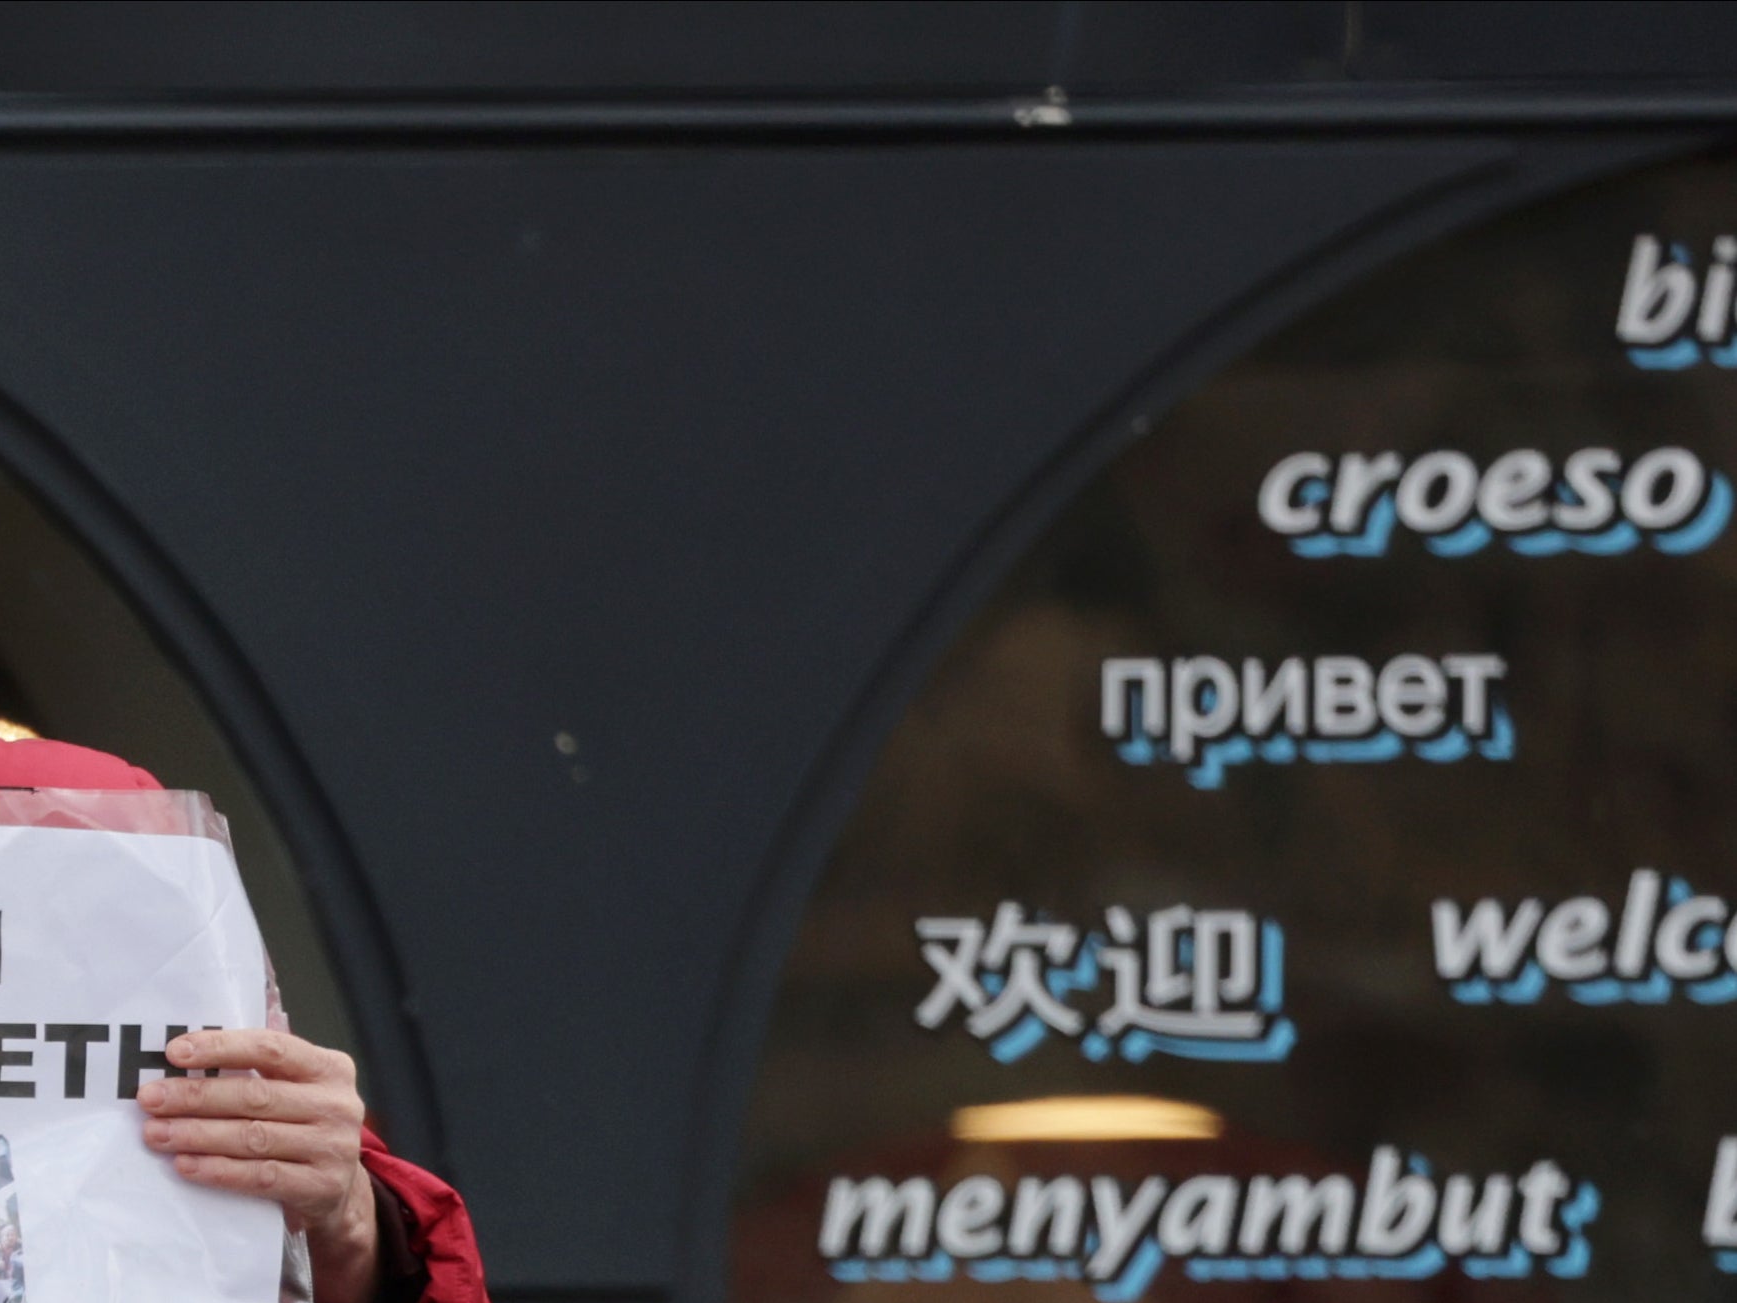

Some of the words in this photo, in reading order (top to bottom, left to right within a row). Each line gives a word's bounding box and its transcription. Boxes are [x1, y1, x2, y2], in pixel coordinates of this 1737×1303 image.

[1258, 447, 1706, 535] croeso
[1101, 654, 1505, 762] привет
[916, 901, 1265, 1040] 欢迎
[1431, 868, 1737, 979] welc
[818, 1145, 1570, 1278] menyambut
